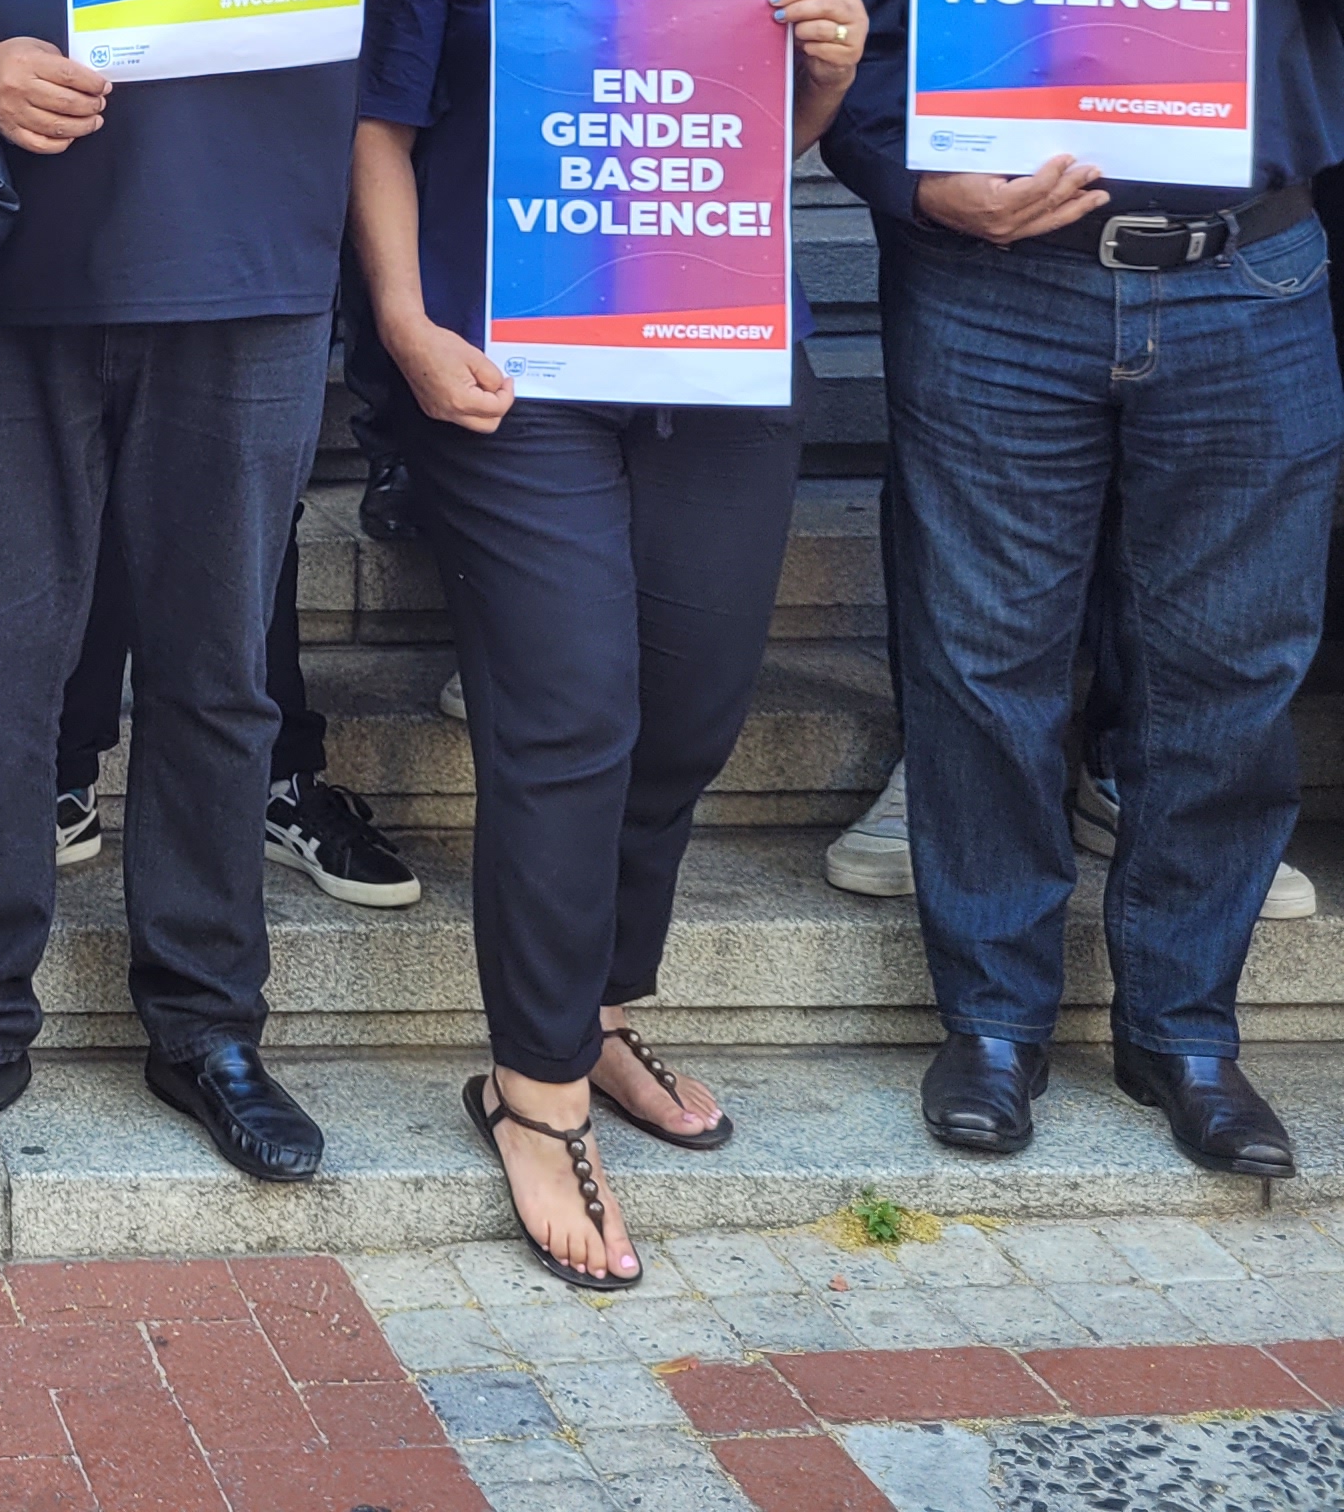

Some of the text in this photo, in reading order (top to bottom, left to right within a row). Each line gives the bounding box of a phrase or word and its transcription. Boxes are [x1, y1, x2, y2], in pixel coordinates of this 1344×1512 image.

[593, 69, 695, 104] END
[1079, 96, 1232, 118] #WCGENDGBV
[541, 112, 743, 149] GENDER
[560, 157, 724, 192] BASED
[507, 198, 772, 237] VIOLENCE!
[642, 323, 775, 340] #WCGENDGBV
